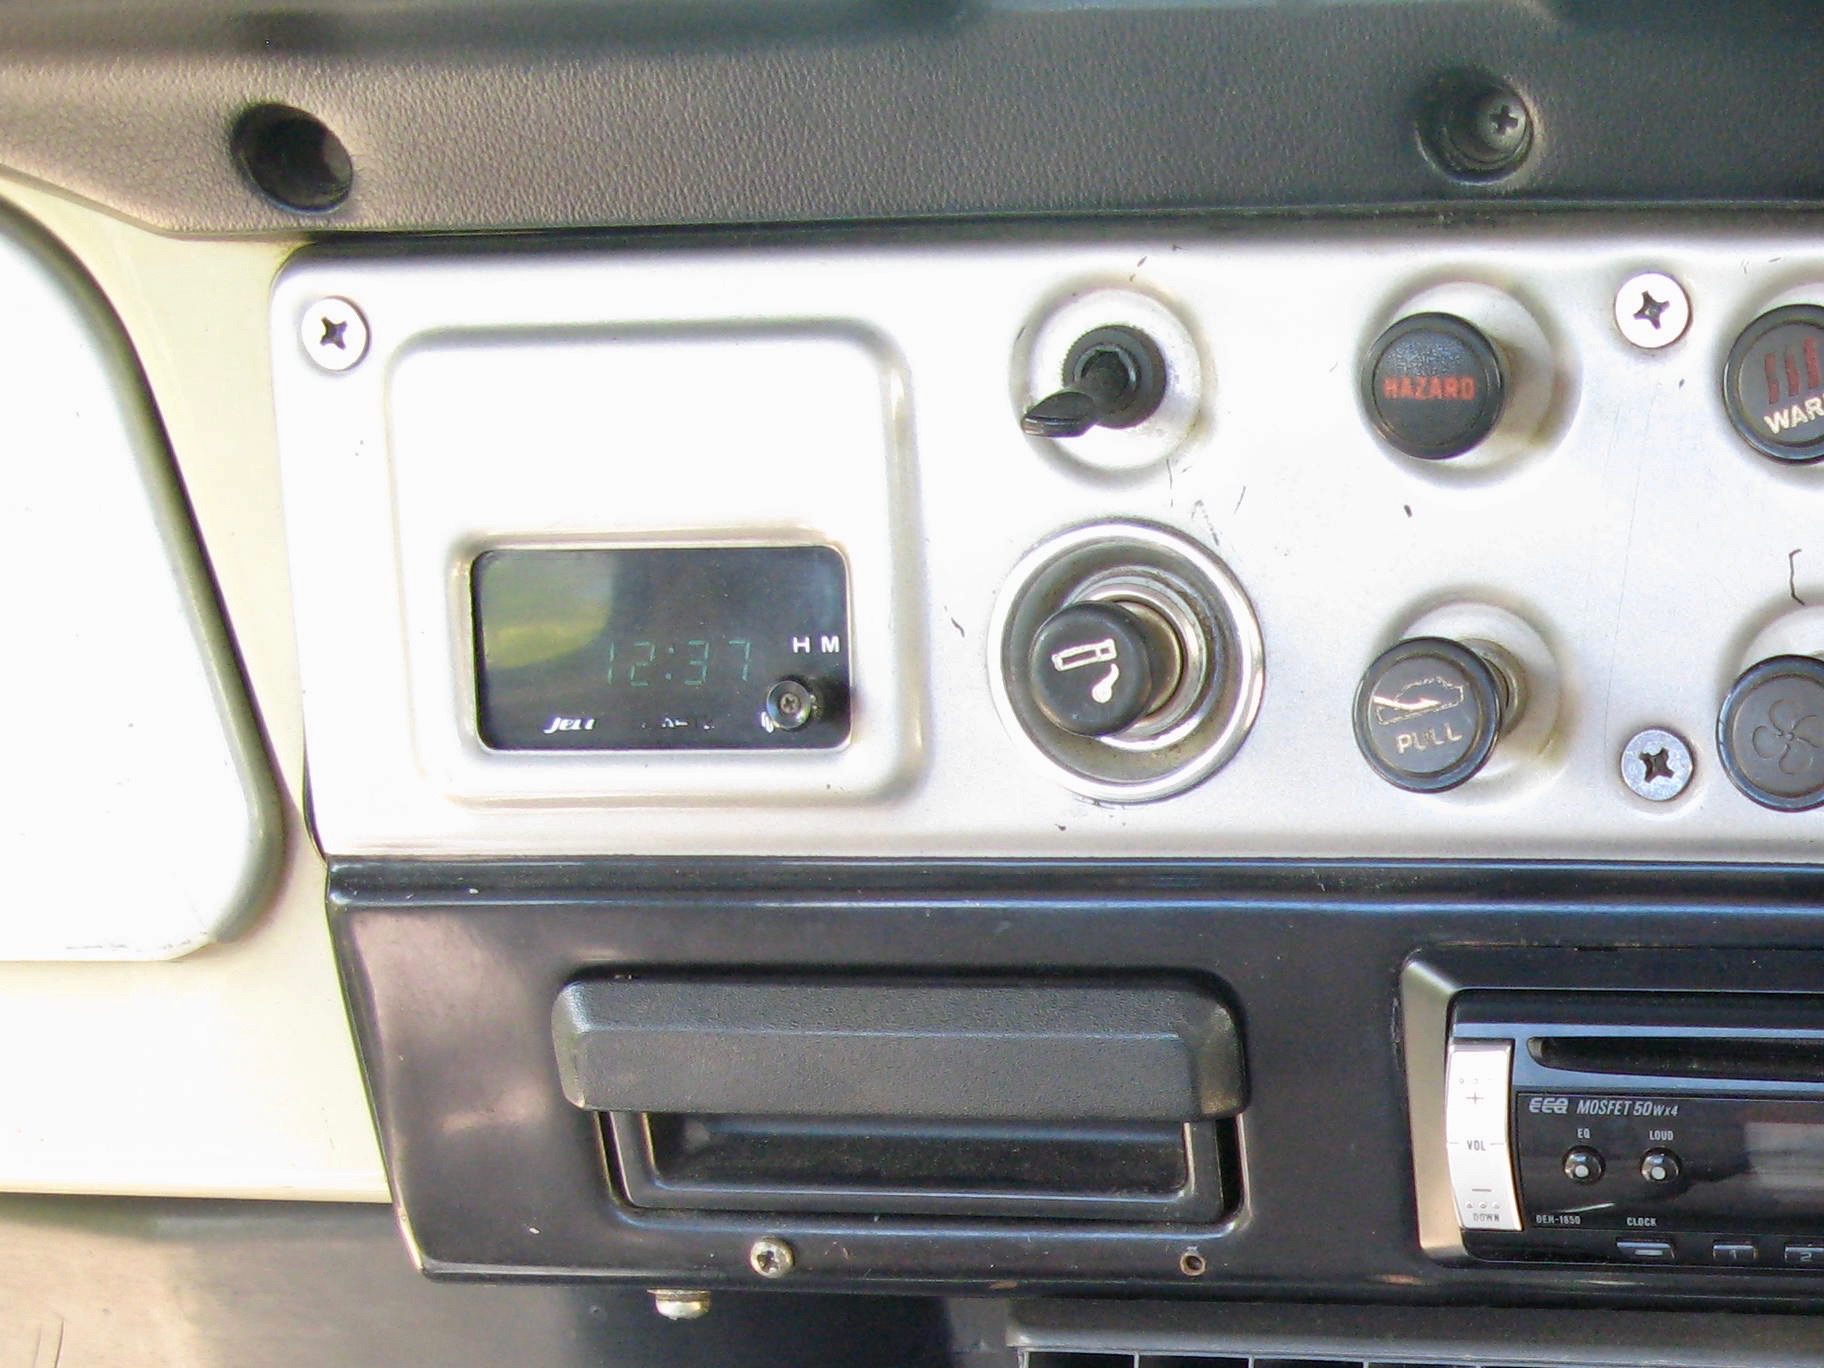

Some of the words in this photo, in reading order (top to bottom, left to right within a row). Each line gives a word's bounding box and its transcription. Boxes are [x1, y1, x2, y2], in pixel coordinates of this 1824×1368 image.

[1383, 375, 1477, 400] HAZARD
[608, 639, 750, 687] 12:37
[1396, 722, 1462, 754] PULL
[1577, 1100, 1632, 1116] MOSFET
[1577, 1128, 1591, 1140] EQ
[1649, 1130, 1674, 1141] LOUD
[1467, 1140, 1486, 1151] VOL
[1627, 1217, 1657, 1227] CLOCK
[1800, 1253, 1812, 1262] 2
